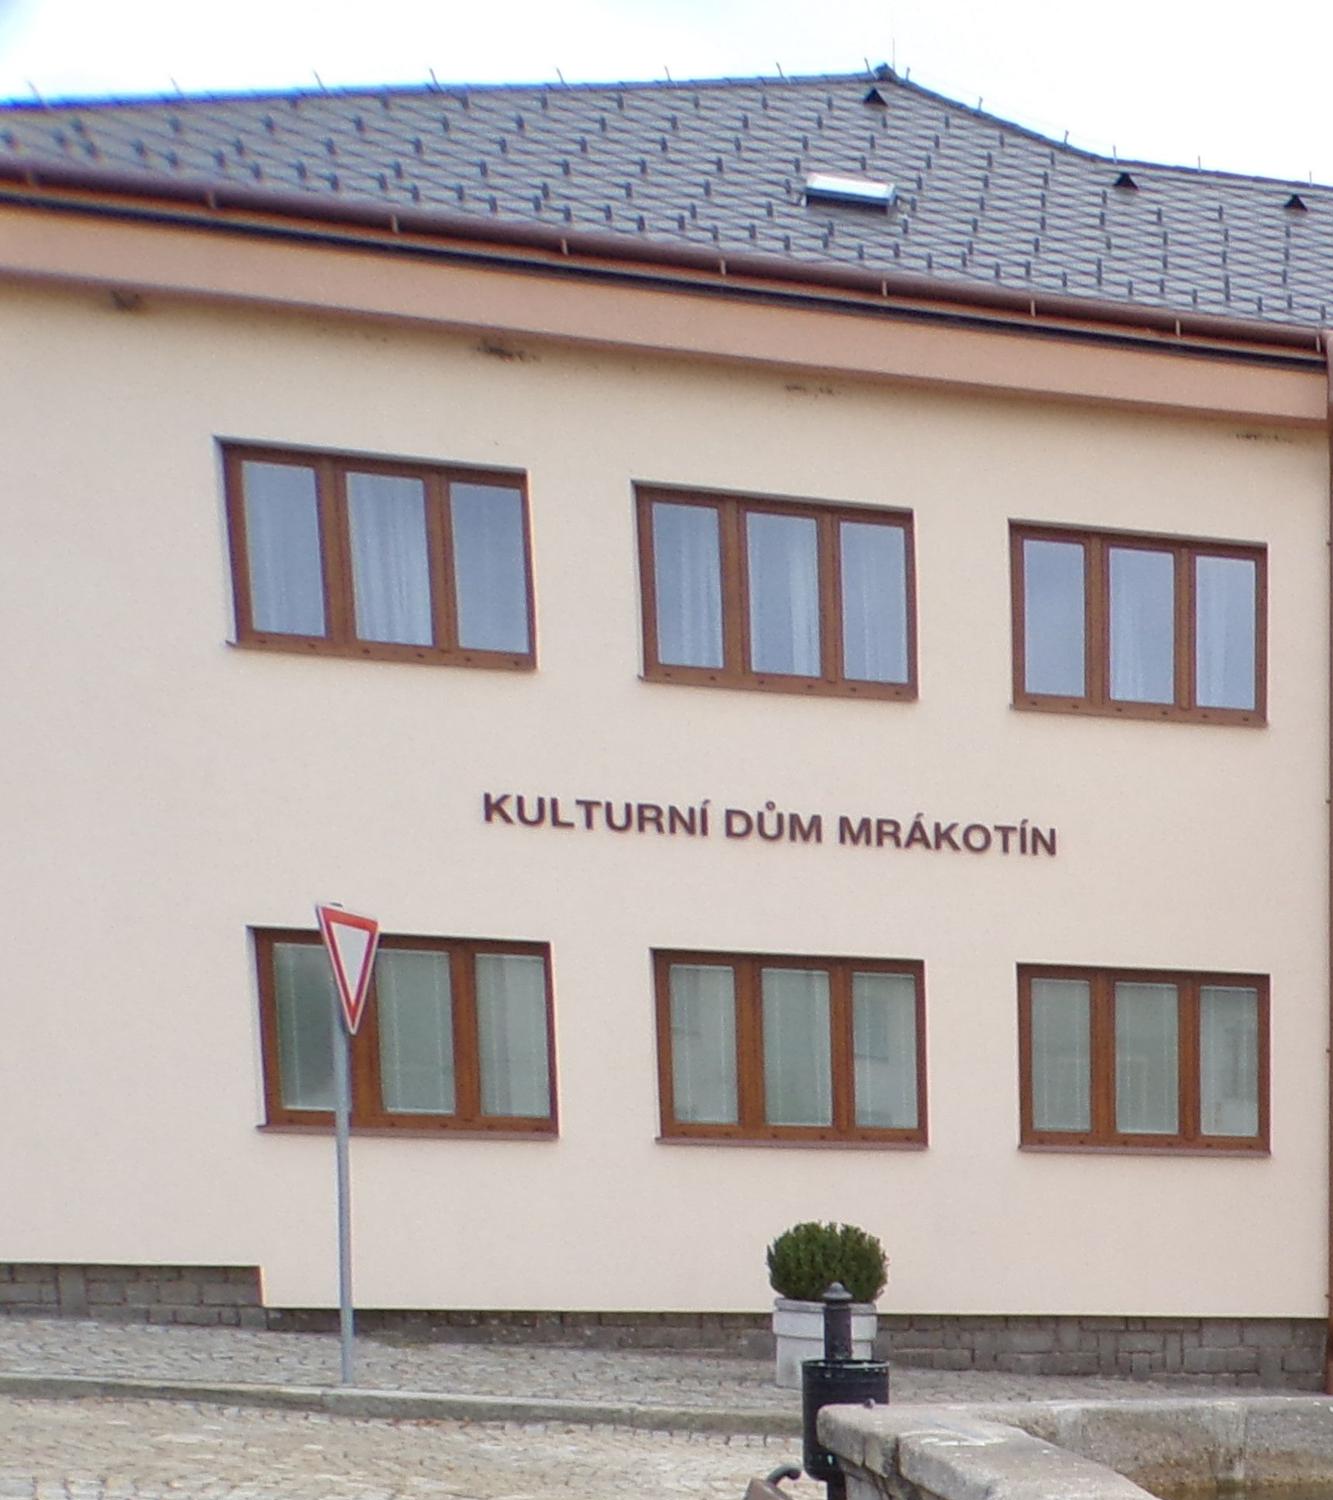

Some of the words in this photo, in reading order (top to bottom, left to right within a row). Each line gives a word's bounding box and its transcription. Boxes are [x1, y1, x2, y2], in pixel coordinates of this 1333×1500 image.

[482, 792, 711, 837] KULTURNÍ
[724, 801, 823, 844] DŮM
[838, 813, 1057, 857] MRÁKOTÍN
